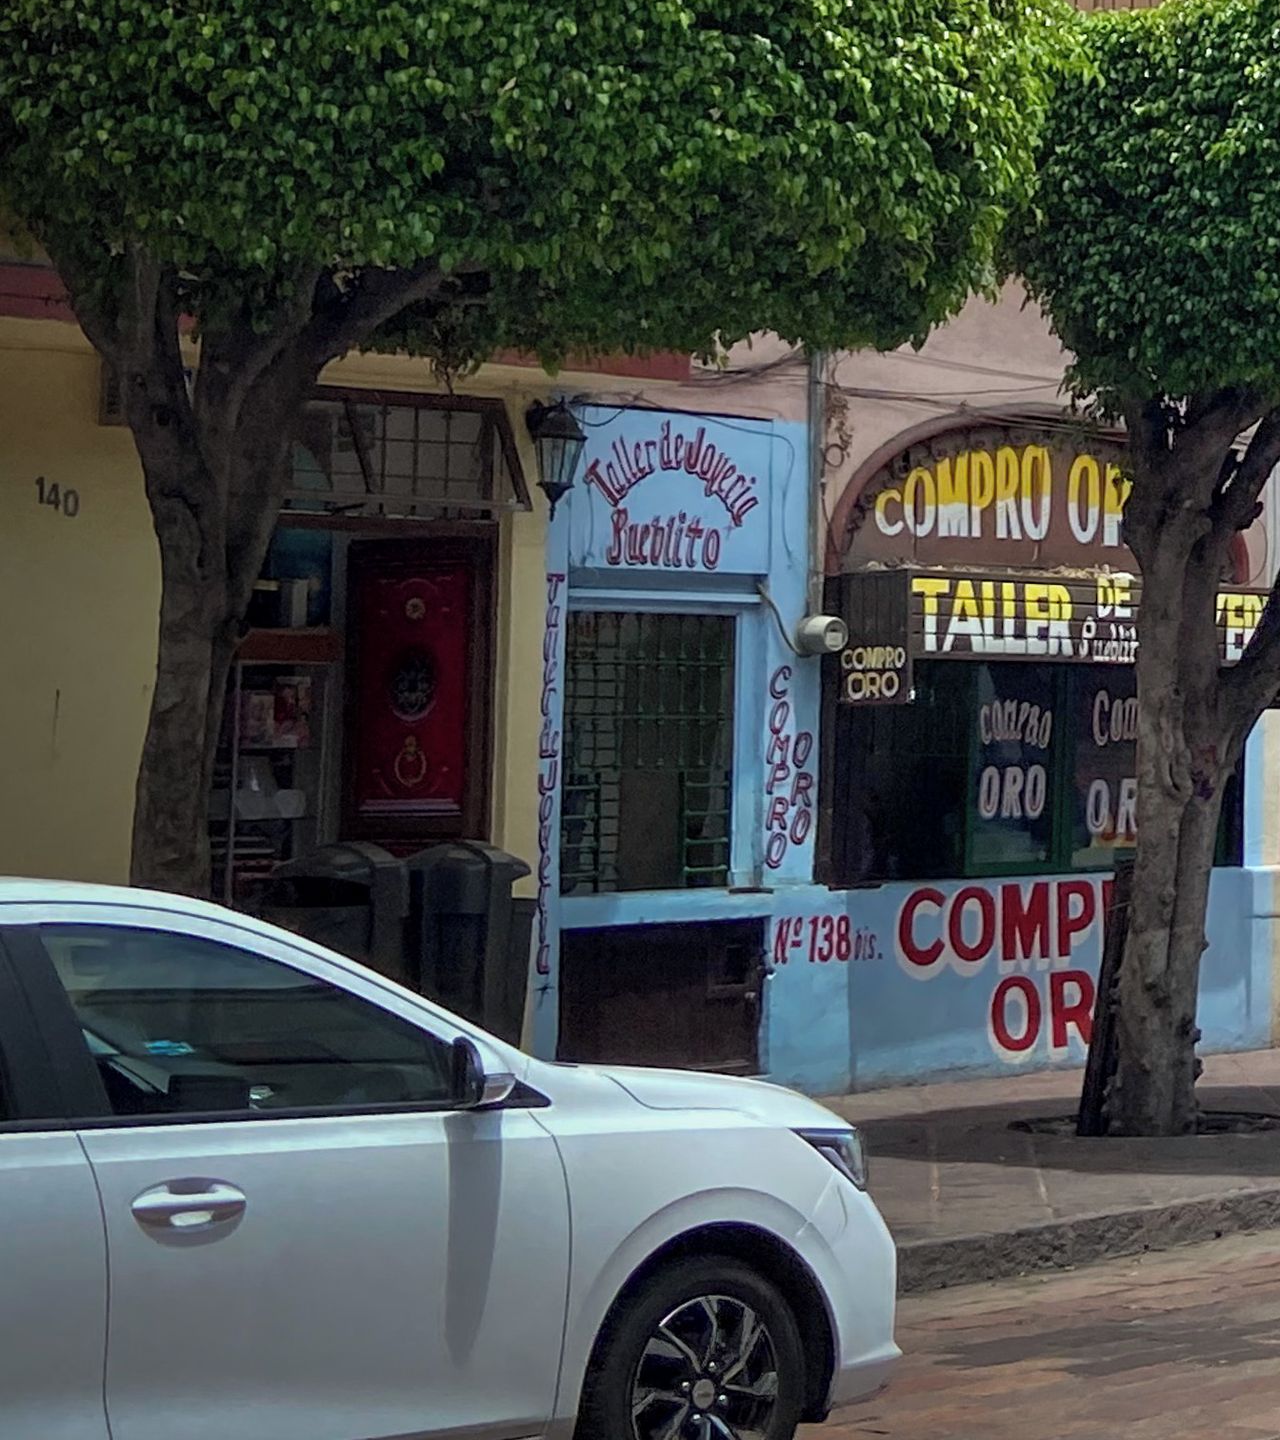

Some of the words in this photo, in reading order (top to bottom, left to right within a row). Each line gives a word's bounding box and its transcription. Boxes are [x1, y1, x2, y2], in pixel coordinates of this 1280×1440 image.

[35, 476, 80, 517] 140
[584, 434, 656, 507] Taller
[659, 420, 685, 471] de
[875, 444, 1052, 541] COMPRO
[1067, 454, 1134, 546] OR
[912, 578, 1074, 657] TALLER
[1097, 578, 1133, 618] DE
[841, 646, 907, 670] COMPRO
[847, 671, 900, 701] ORO
[765, 665, 792, 868] COMPRO
[790, 732, 813, 845] ORO
[978, 764, 1047, 820] ORO
[1086, 778, 1137, 835] OR
[807, 915, 851, 962] 138
[898, 880, 1114, 967] COMP
[991, 970, 1096, 1052] OR
